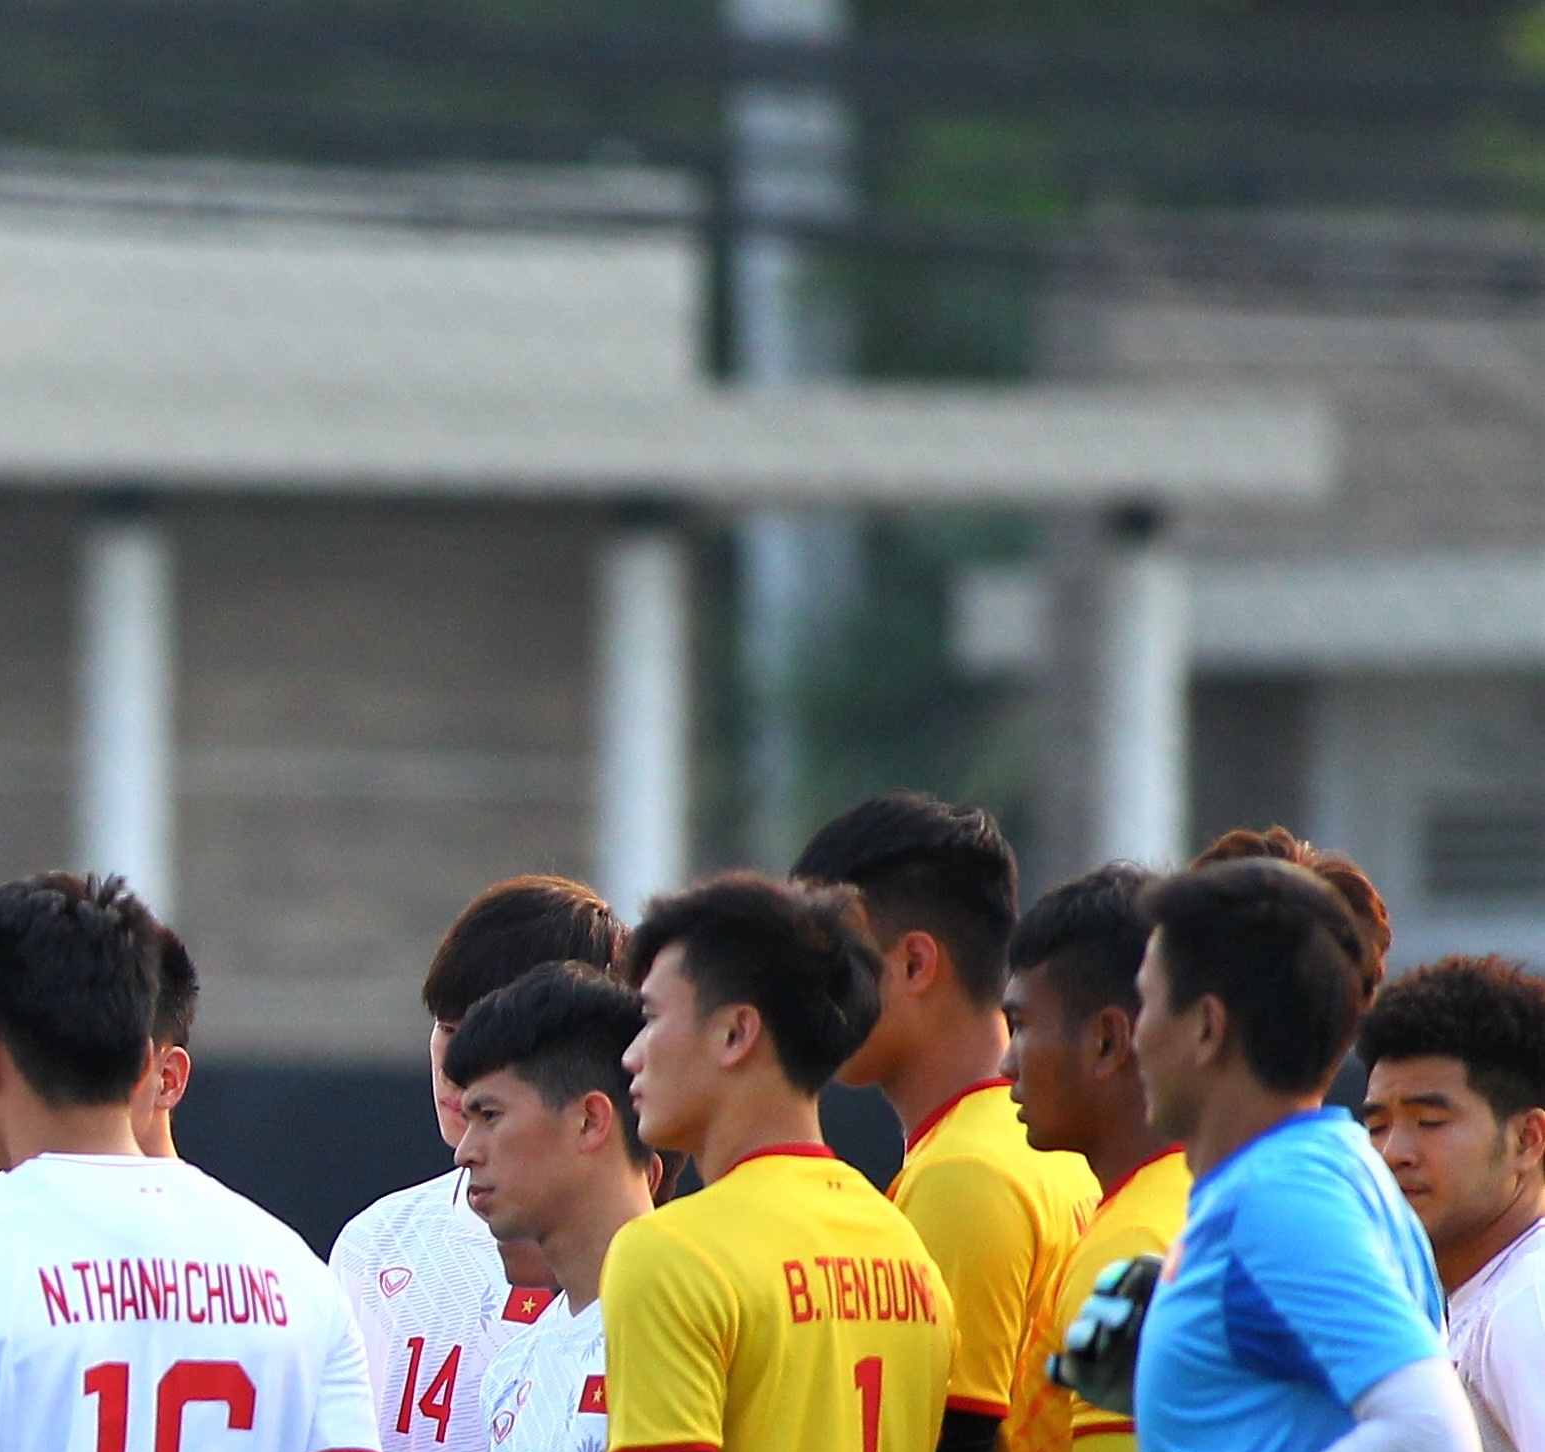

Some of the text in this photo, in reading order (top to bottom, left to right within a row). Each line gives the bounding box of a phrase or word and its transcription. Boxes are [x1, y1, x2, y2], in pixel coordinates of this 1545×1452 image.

[38, 1257, 288, 1328] N.THANH CHUNG
[783, 1256, 871, 1323] B.TIEN
[396, 1336, 463, 1444] 14
